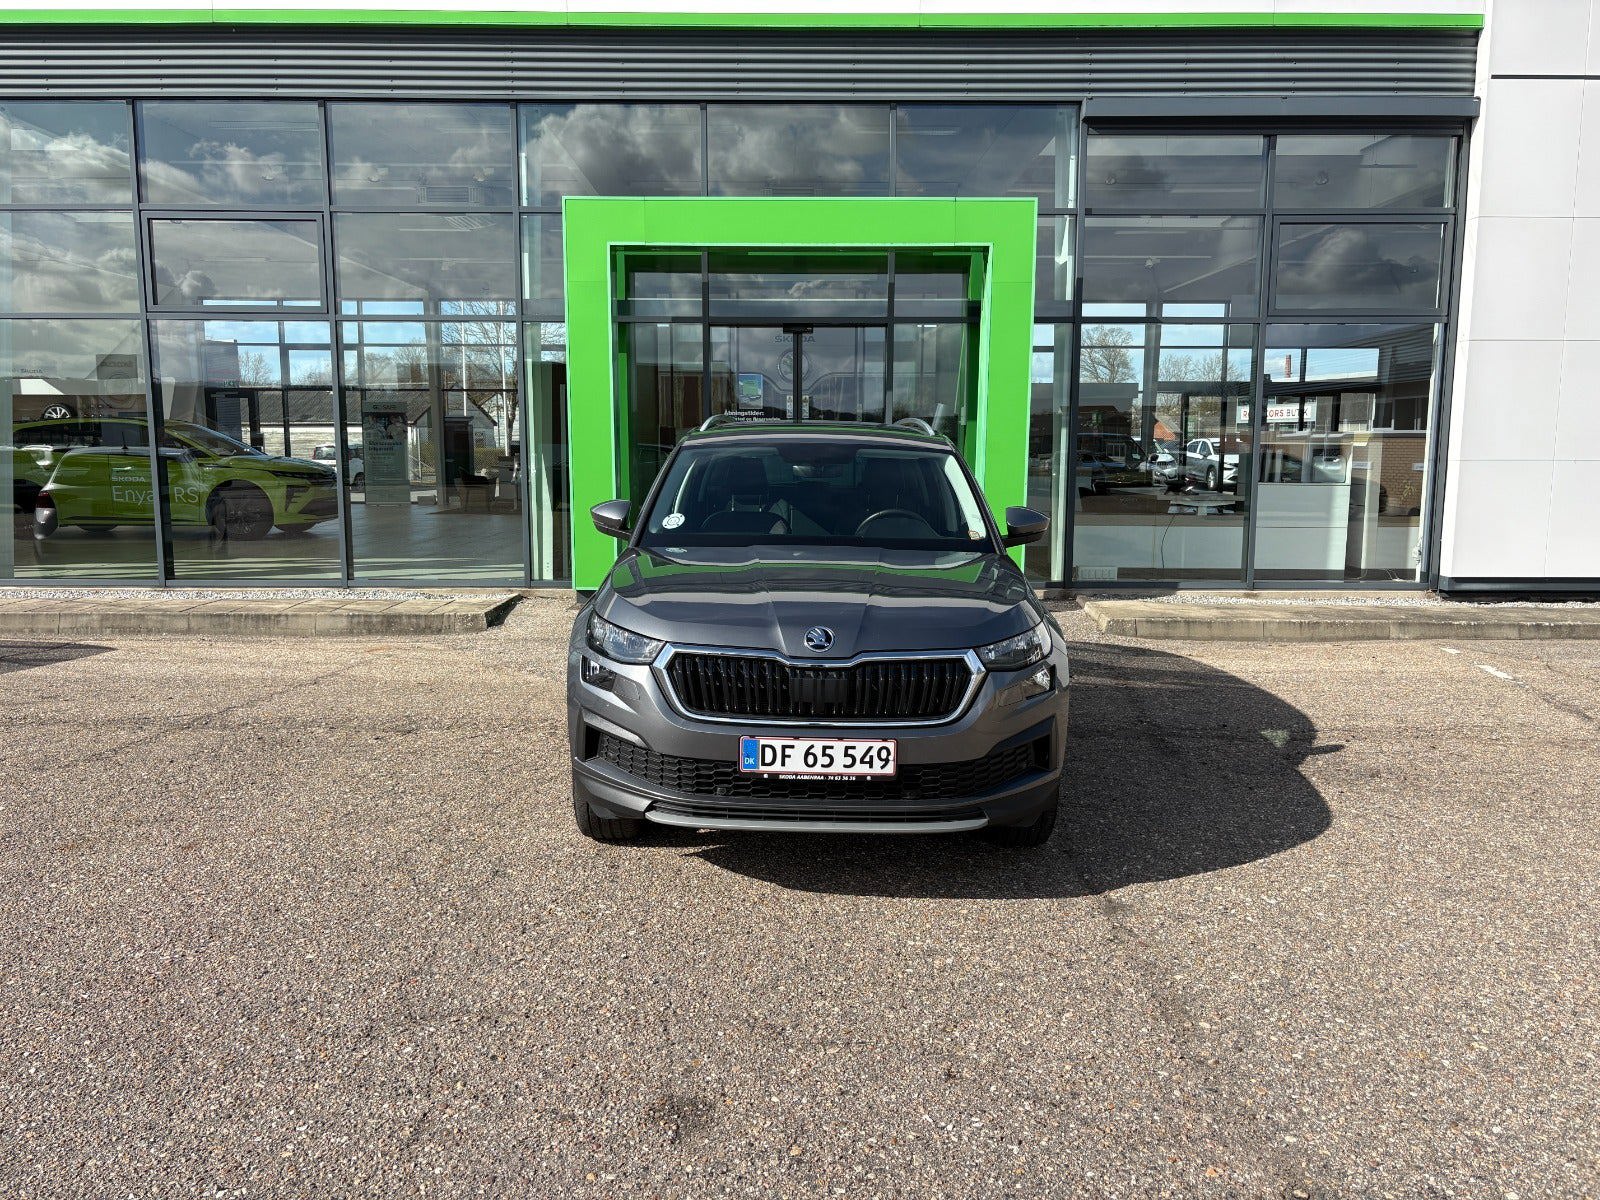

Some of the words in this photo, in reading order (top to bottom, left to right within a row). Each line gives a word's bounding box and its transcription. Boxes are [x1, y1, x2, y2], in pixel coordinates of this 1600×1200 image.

[112, 485, 156, 506] Enya
[174, 486, 199, 503] RS
[744, 757, 755, 766] DK
[760, 743, 795, 767] DF
[803, 744, 835, 769] 65
[842, 745, 892, 770] 549
